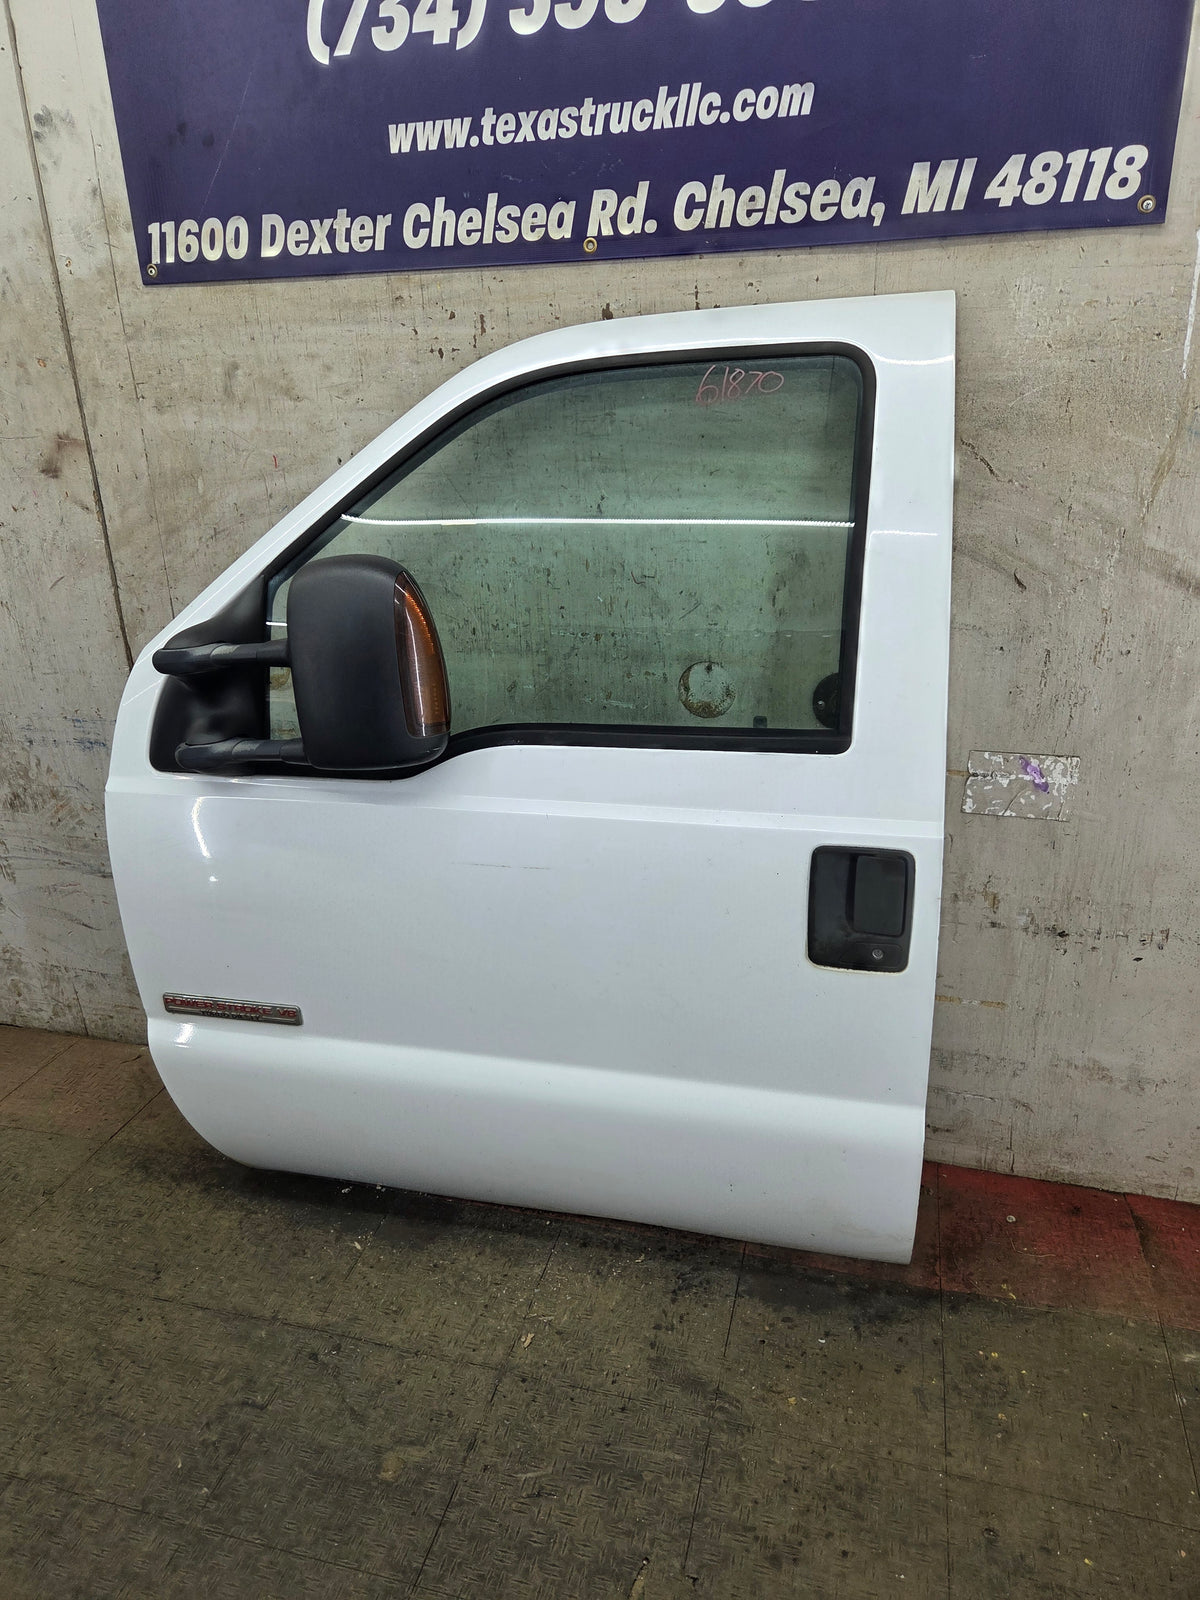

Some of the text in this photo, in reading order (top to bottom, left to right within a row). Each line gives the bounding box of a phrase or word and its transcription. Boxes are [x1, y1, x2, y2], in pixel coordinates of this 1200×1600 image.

[388, 82, 815, 154] www.texastruckllc.com
[147, 144, 1149, 265] 11600 Dexter Chelsea Rd. Chelsea, MI 48118
[695, 364, 785, 406] 61870
[164, 997, 213, 1010] POWER
[216, 1002, 272, 1014] STROKE
